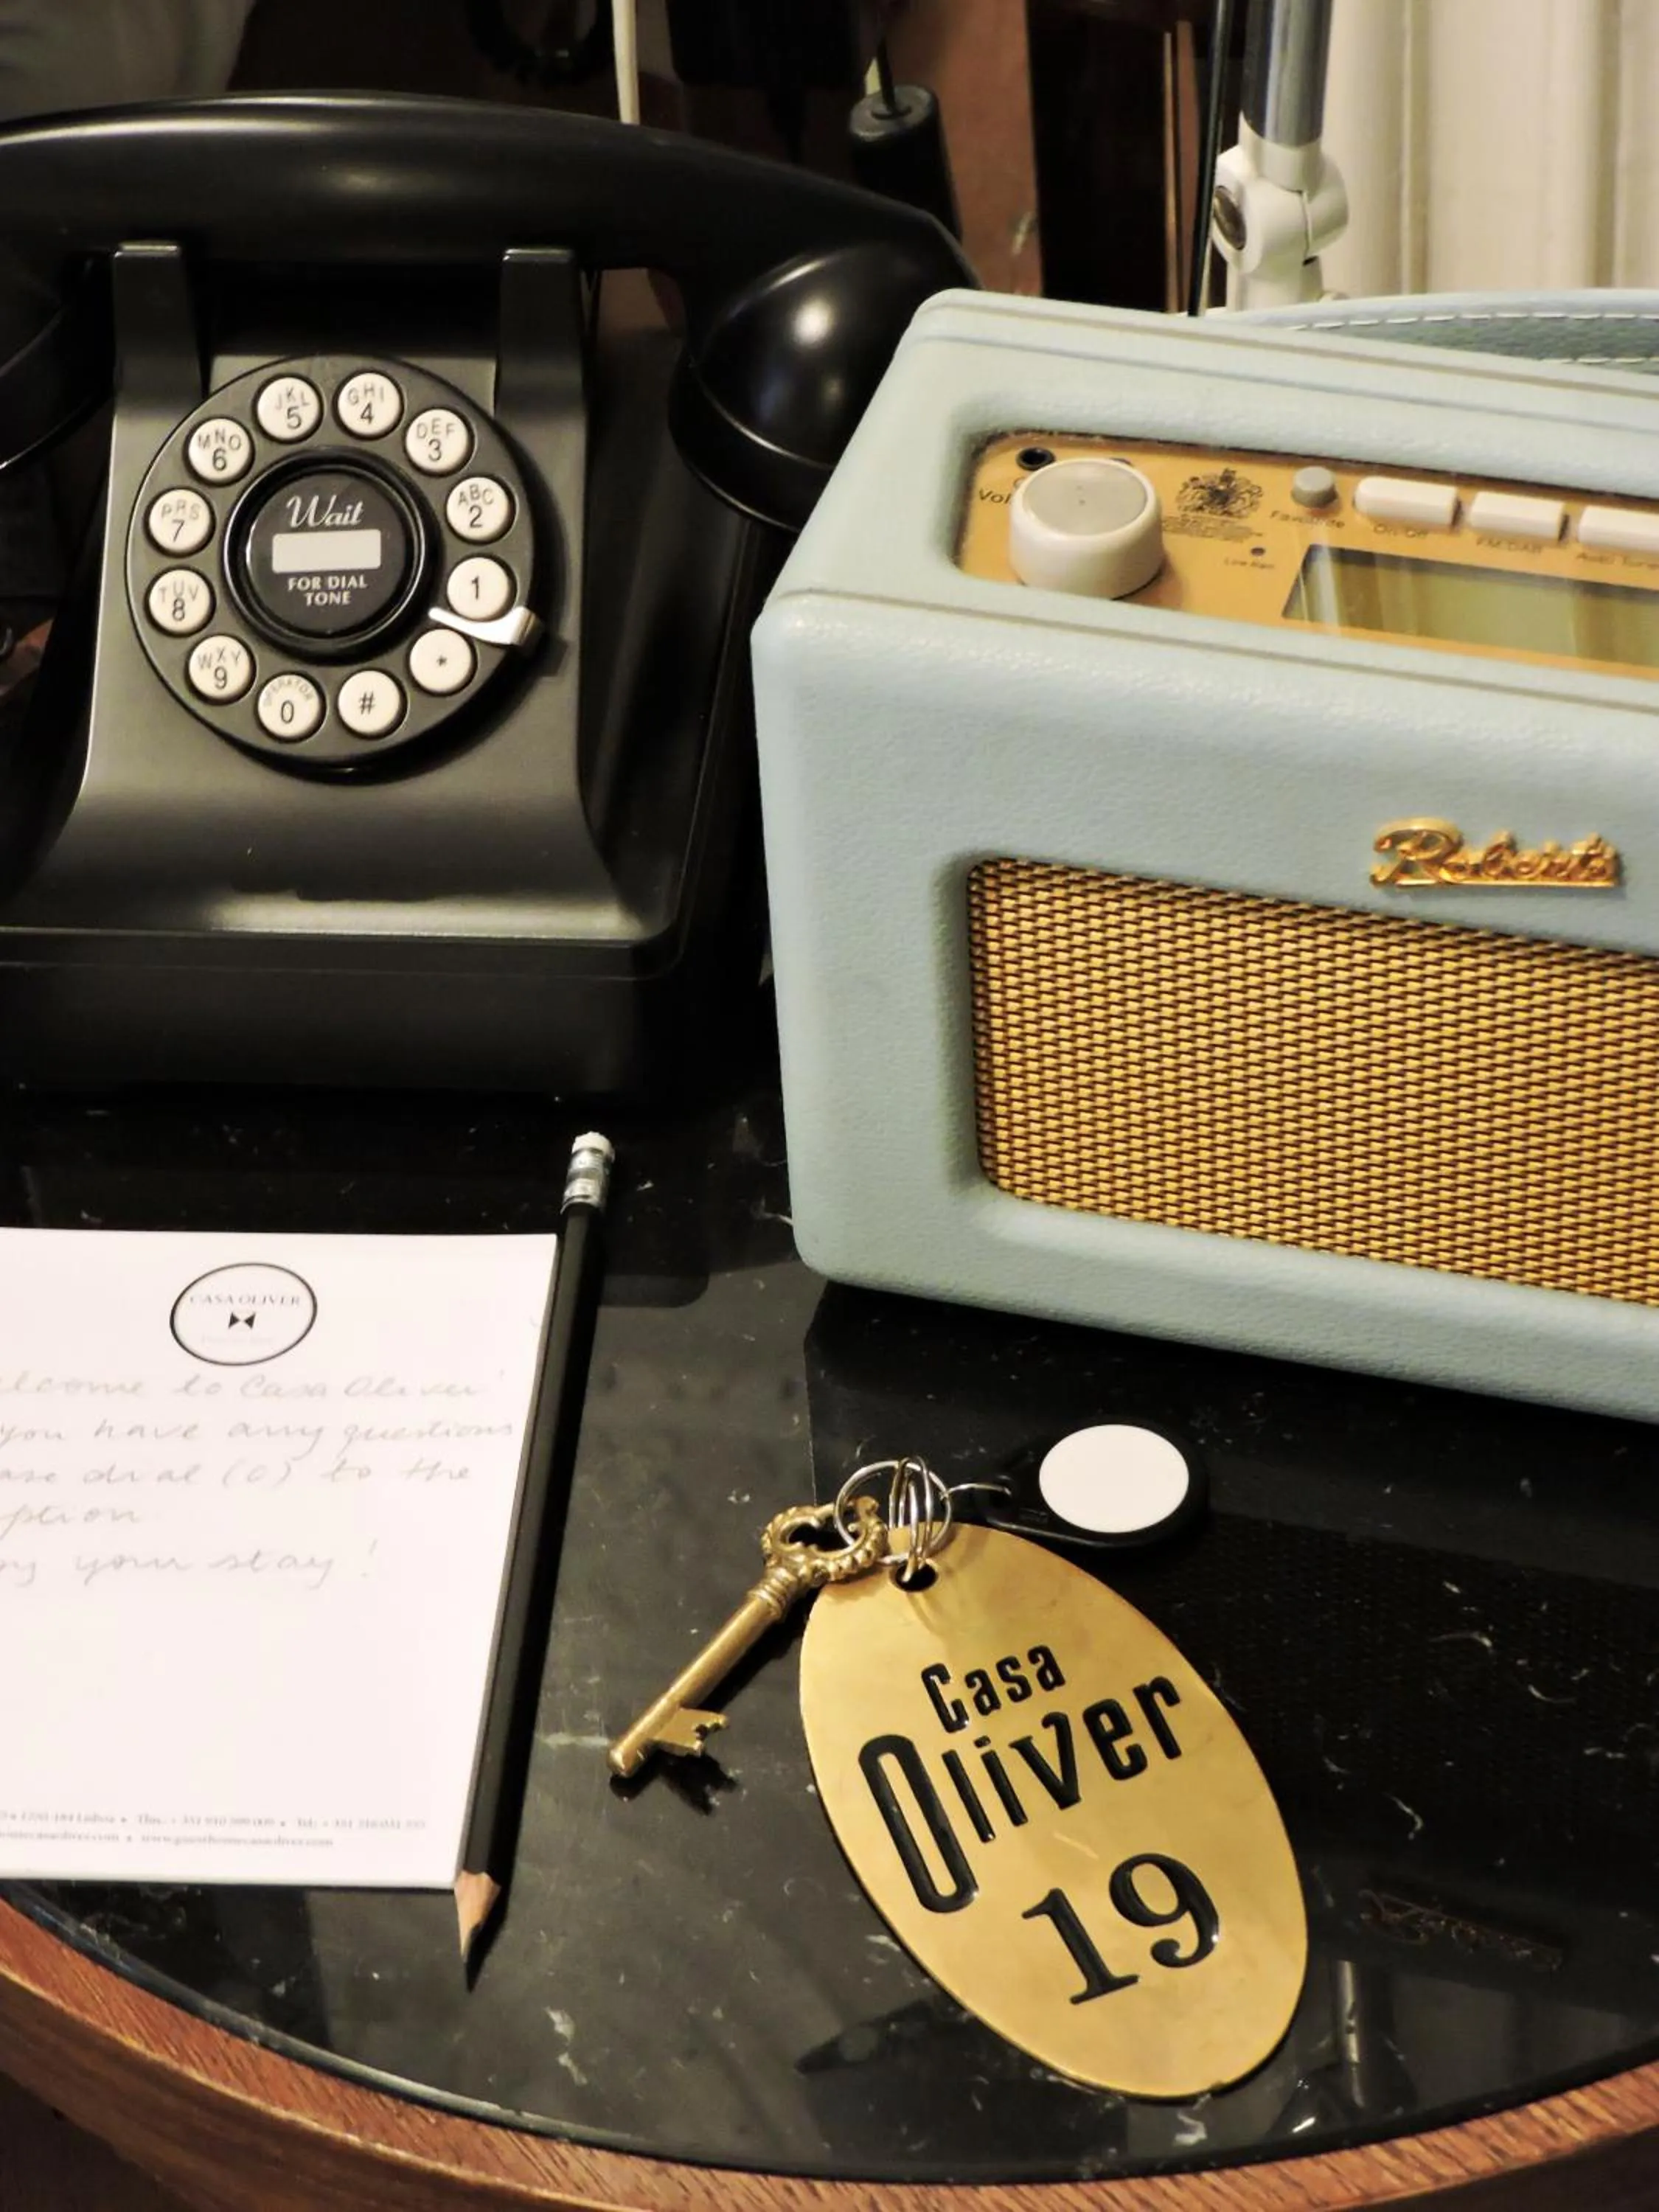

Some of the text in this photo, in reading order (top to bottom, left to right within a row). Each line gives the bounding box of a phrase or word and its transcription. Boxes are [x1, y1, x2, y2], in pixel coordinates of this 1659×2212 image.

[276, 388, 310, 411] JKL
[347, 386, 384, 406] GHI
[286, 406, 302, 430] 5
[359, 407, 374, 425] 4
[417, 417, 456, 440] DEF
[197, 431, 242, 452] MNO
[428, 438, 442, 462] 3
[212, 448, 228, 473] 6
[458, 484, 494, 506] ABC
[286, 493, 364, 529] Wait
[468, 505, 483, 529] 2
[171, 520, 184, 543] 7
[159, 580, 199, 604] TUV
[288, 574, 367, 591] FOR DIAL
[470, 576, 481, 599] 1
[172, 597, 186, 622] 8
[305, 591, 352, 606] TONE
[198, 647, 241, 670] WXY
[213, 667, 229, 690] 9
[358, 692, 375, 715] #
[189, 1293, 301, 1306] CASA OLIVER
[94, 1418, 202, 1441] have
[227, 1421, 324, 1460] any
[328, 1419, 514, 1461] questions
[83, 1461, 201, 1485] dial
[319, 1457, 372, 1485] to
[401, 1456, 470, 1484] the
[0, 1503, 141, 1540] ption
[921, 1645, 1066, 1733] Casa
[858, 1675, 1183, 1914] Oliver
[1021, 1852, 1220, 2005] 19
